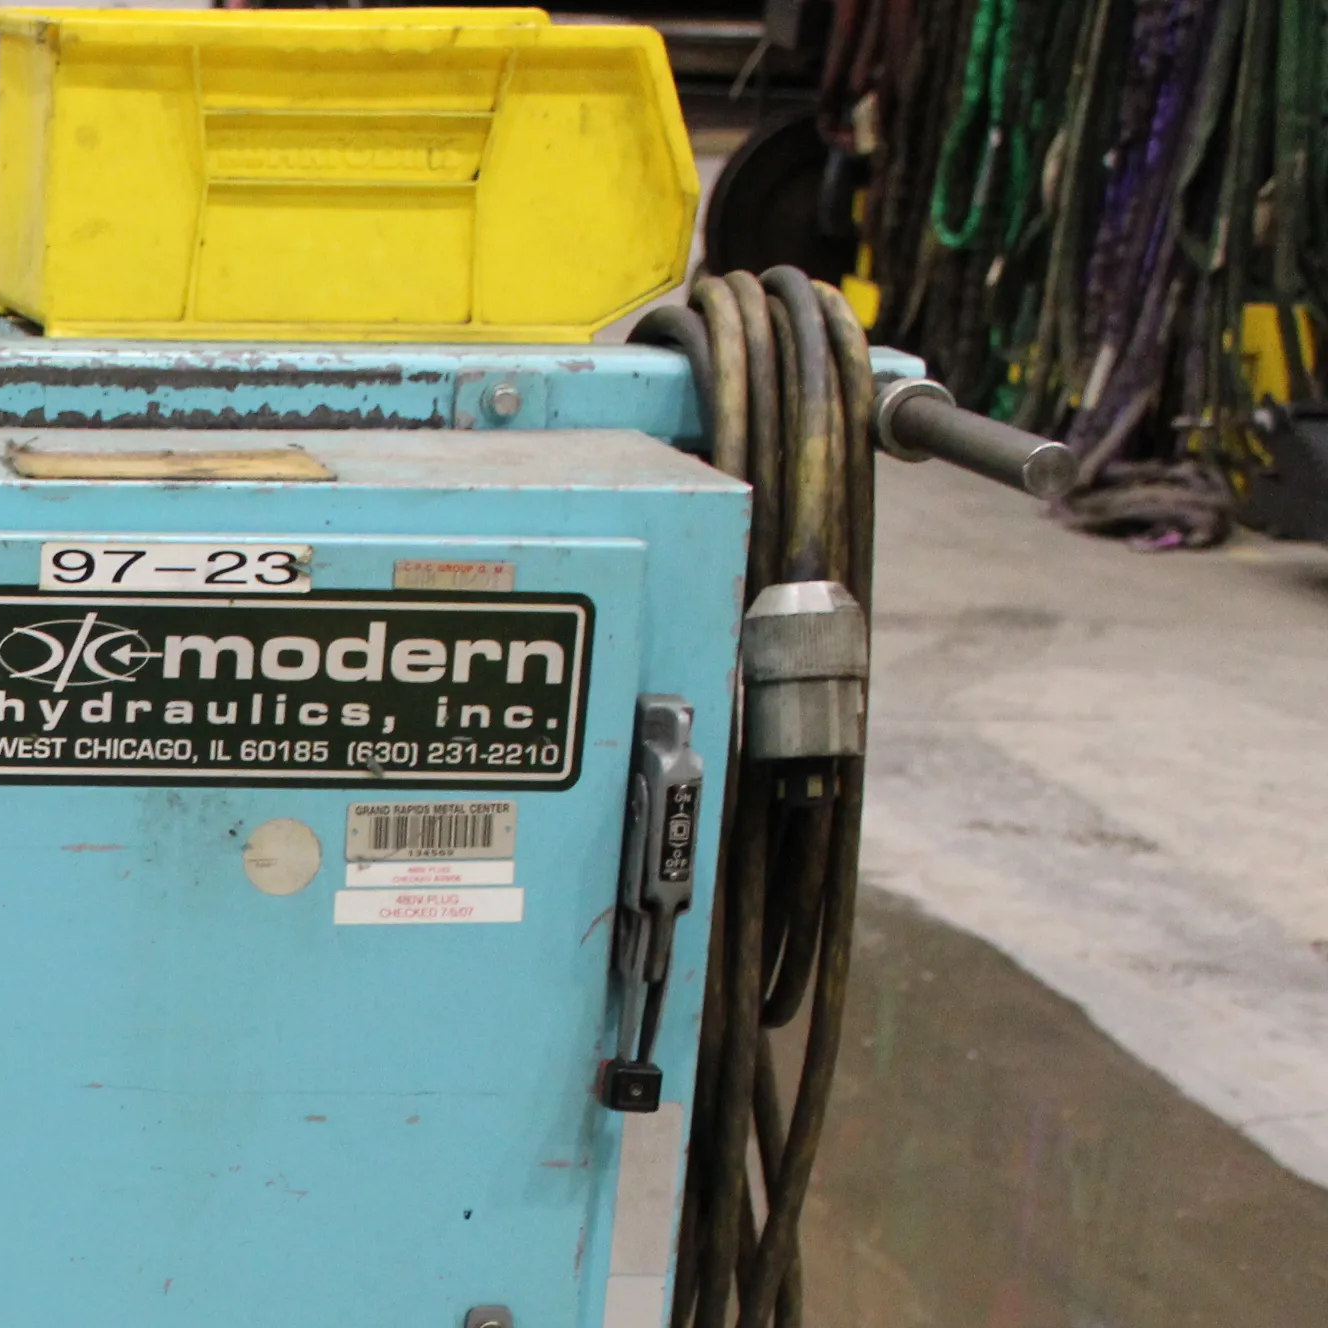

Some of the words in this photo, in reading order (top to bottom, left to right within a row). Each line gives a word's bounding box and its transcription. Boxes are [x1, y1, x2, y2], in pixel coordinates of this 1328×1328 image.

[52, 549, 300, 585] 97-23
[162, 621, 564, 685] modern
[436, 696, 557, 729] inc.
[74, 737, 198, 763] CHICAGO,
[209, 739, 232, 761] IL
[240, 739, 329, 762] 60185
[347, 741, 419, 766] (630)
[427, 742, 559, 766] 231-2210
[355, 805, 390, 816] GRAND
[394, 804, 430, 815] RAPIDS
[433, 804, 465, 814] METAL
[469, 803, 510, 814] CENTER
[675, 793, 691, 803] ON
[665, 858, 688, 868] OFF
